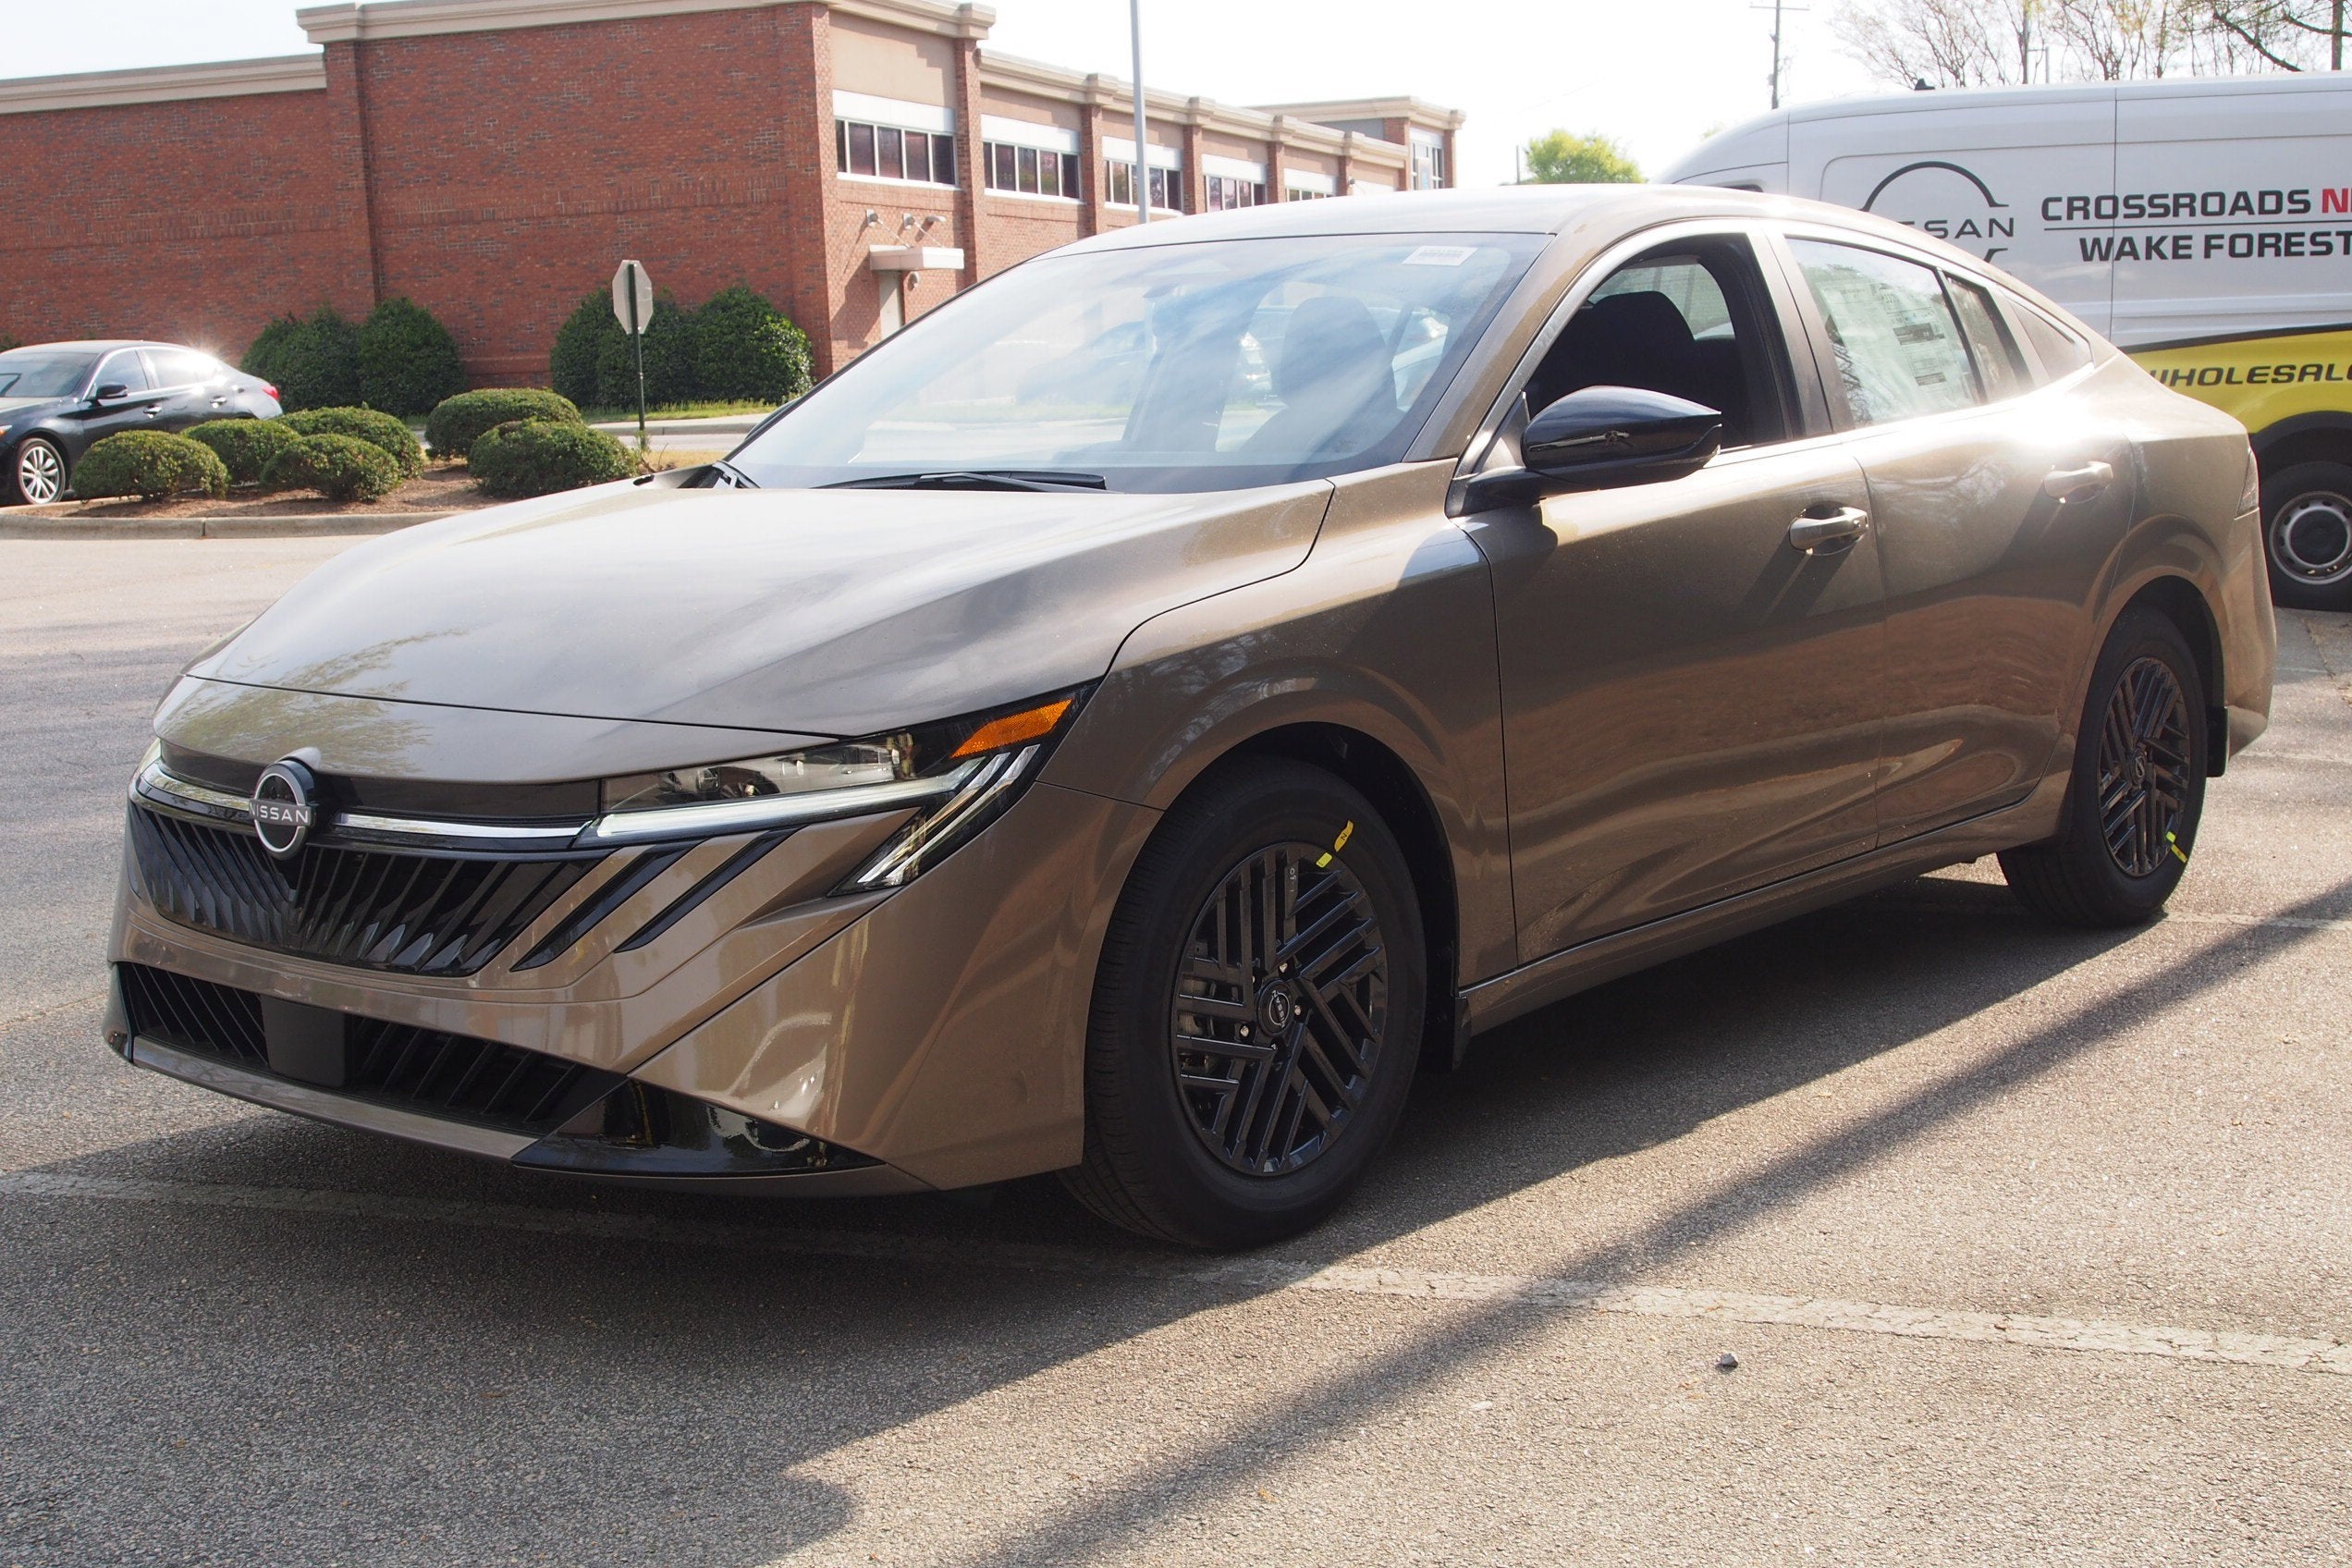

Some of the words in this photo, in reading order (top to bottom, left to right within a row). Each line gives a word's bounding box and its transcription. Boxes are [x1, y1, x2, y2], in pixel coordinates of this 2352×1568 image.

[2041, 189, 2311, 221] CROSSROADS
[2321, 188, 2352, 214] N
[1897, 217, 2014, 239] SAN
[2079, 235, 2193, 262] WAKE
[2203, 231, 2352, 259] FOREST
[2150, 363, 2352, 387] HOLESAL
[249, 802, 309, 824] NISSAN
